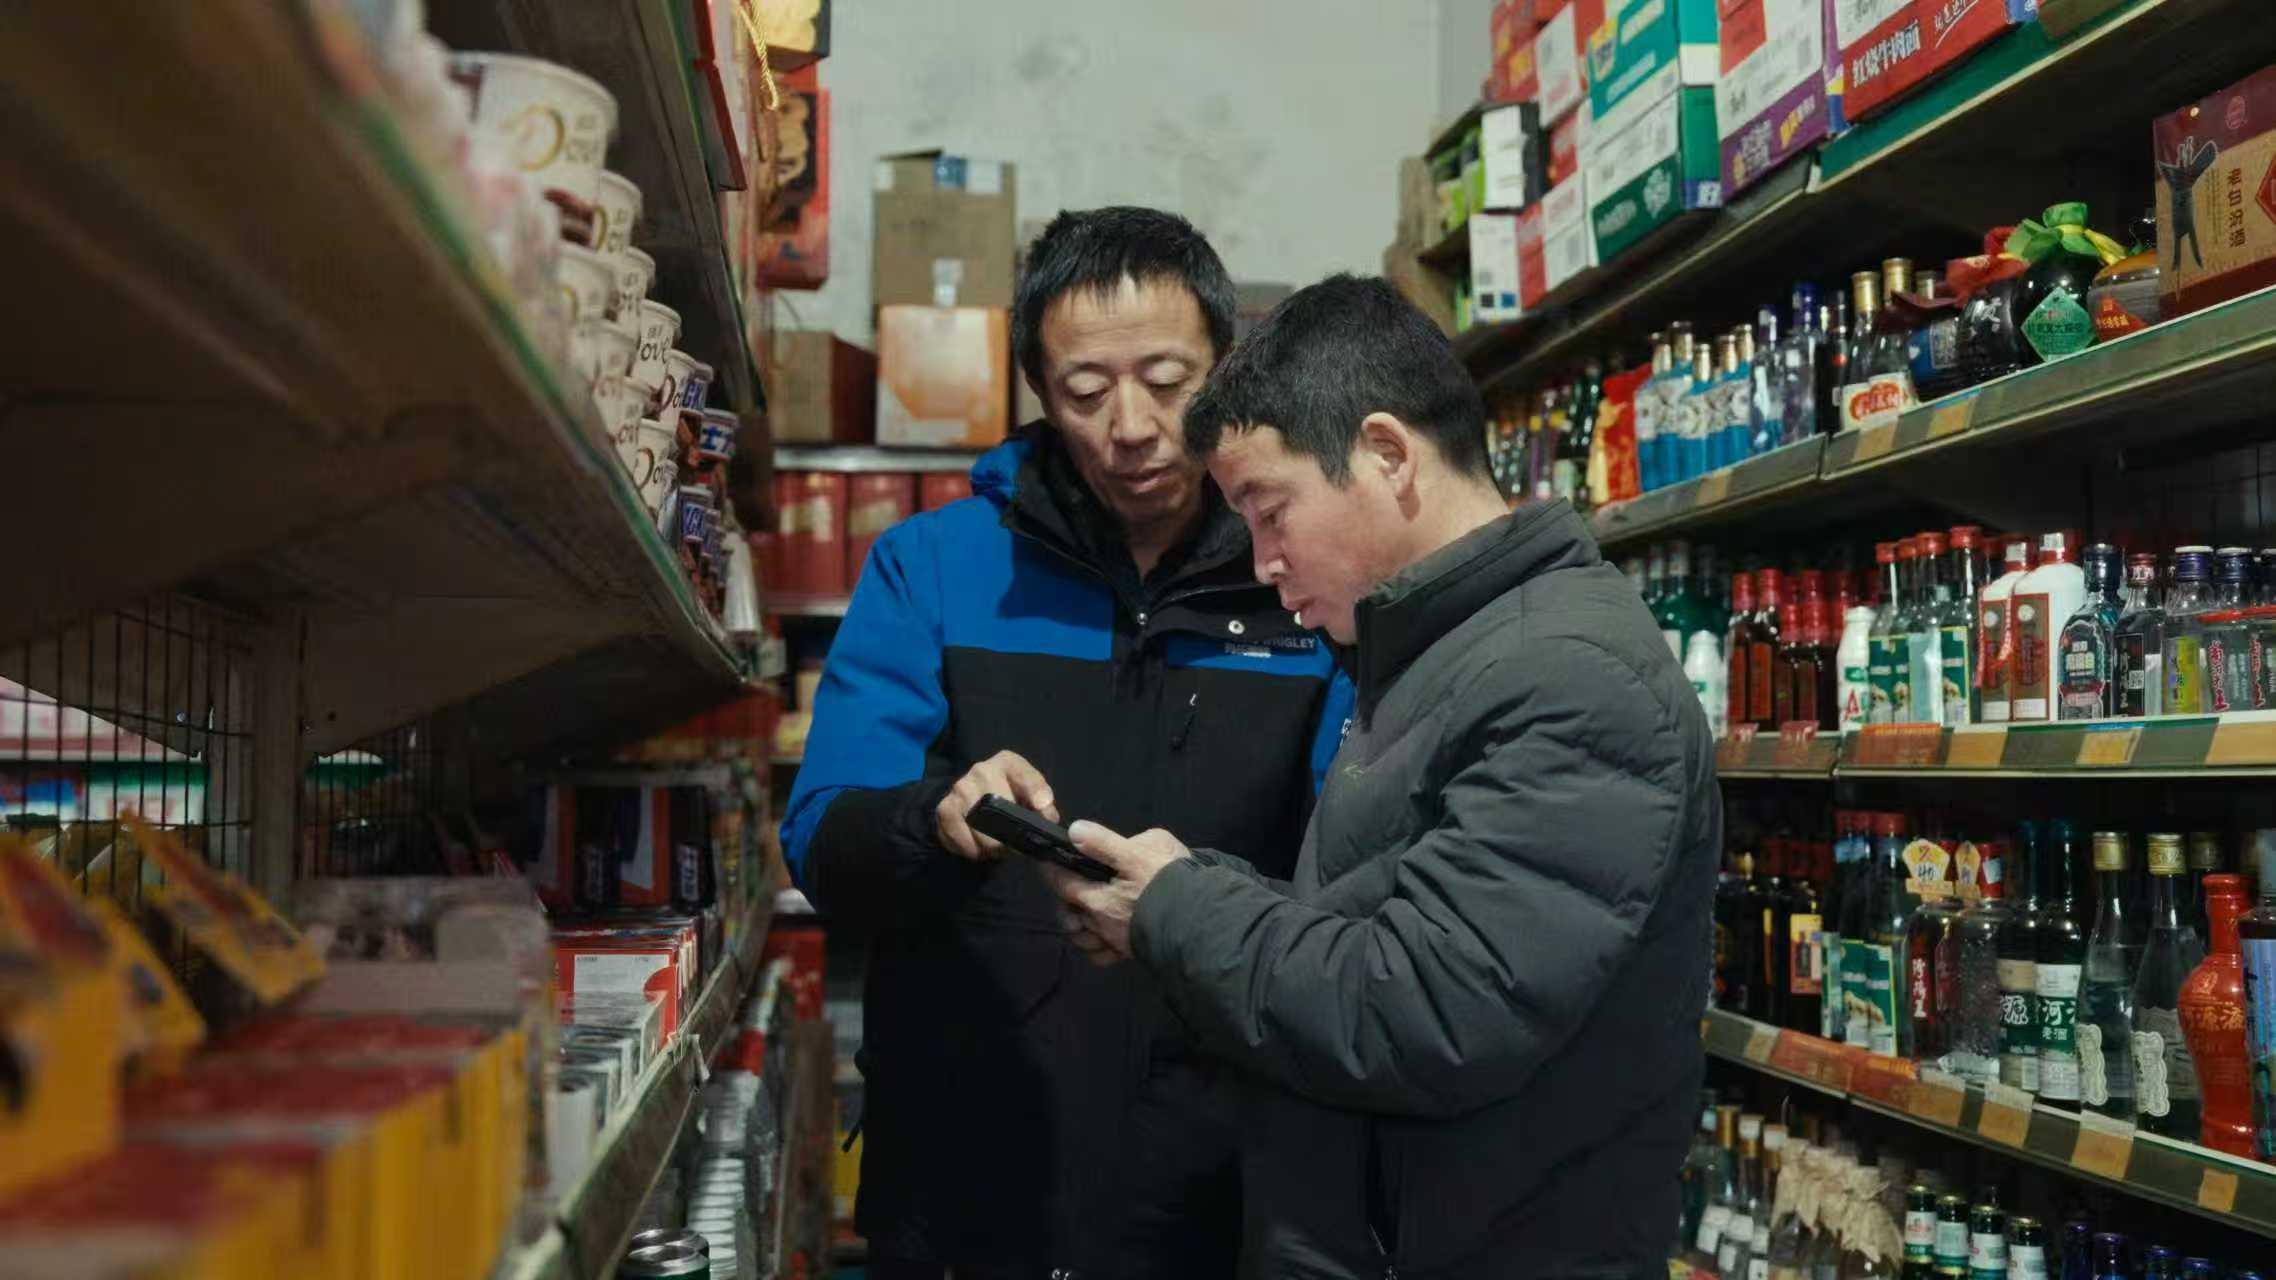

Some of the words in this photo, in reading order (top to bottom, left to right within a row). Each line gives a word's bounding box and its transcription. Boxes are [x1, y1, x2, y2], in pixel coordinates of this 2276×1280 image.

[1852, 19, 1921, 88] 红烧牛肉面
